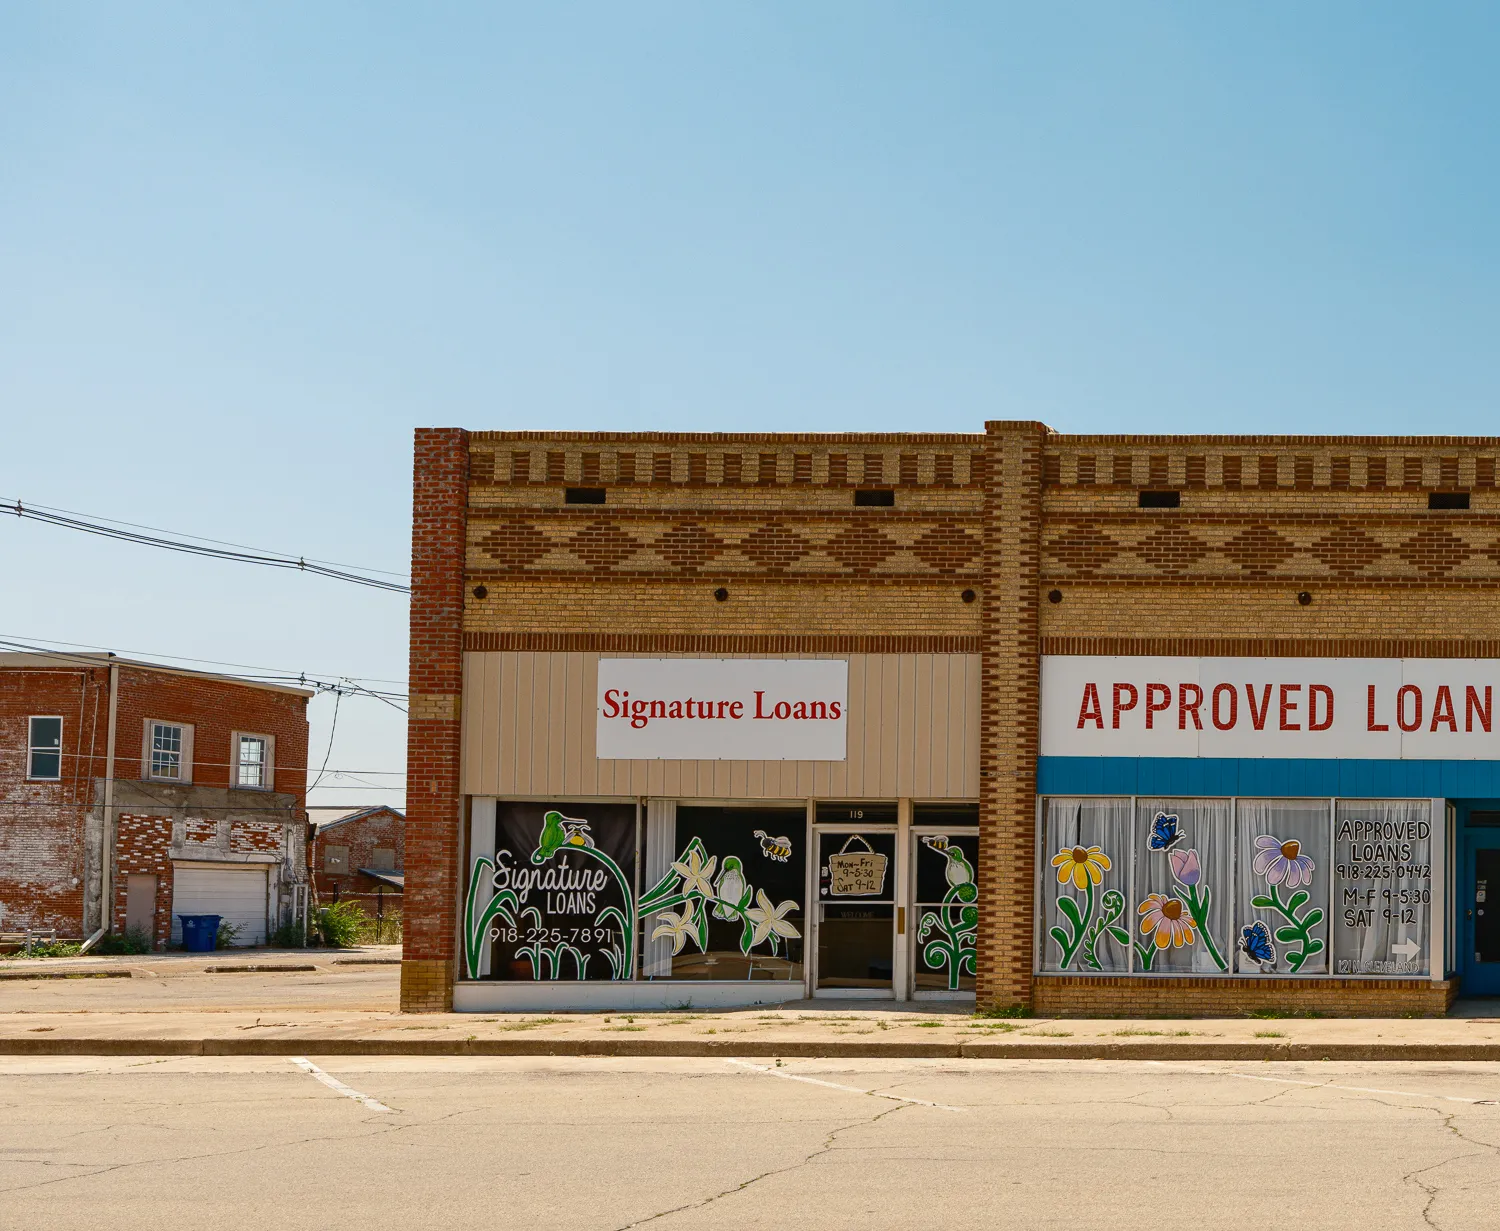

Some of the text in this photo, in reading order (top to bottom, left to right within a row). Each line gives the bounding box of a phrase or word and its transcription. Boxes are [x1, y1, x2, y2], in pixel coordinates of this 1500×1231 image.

[602, 689, 842, 729] Signature Loans
[1077, 683, 1334, 731] APPROVED
[850, 811, 863, 819] 119
[1337, 819, 1431, 841] APPROVED
[1351, 844, 1411, 862] LOANS
[492, 850, 607, 903] Signature
[547, 892, 596, 914] LOANS
[1343, 887, 1431, 906] M-F 9-5:30
[1344, 908, 1417, 928] SAT 9-12
[489, 928, 611, 943] 918-225-7891
[1338, 959, 1352, 973] 121
[1364, 960, 1420, 974] CLEVELAND
